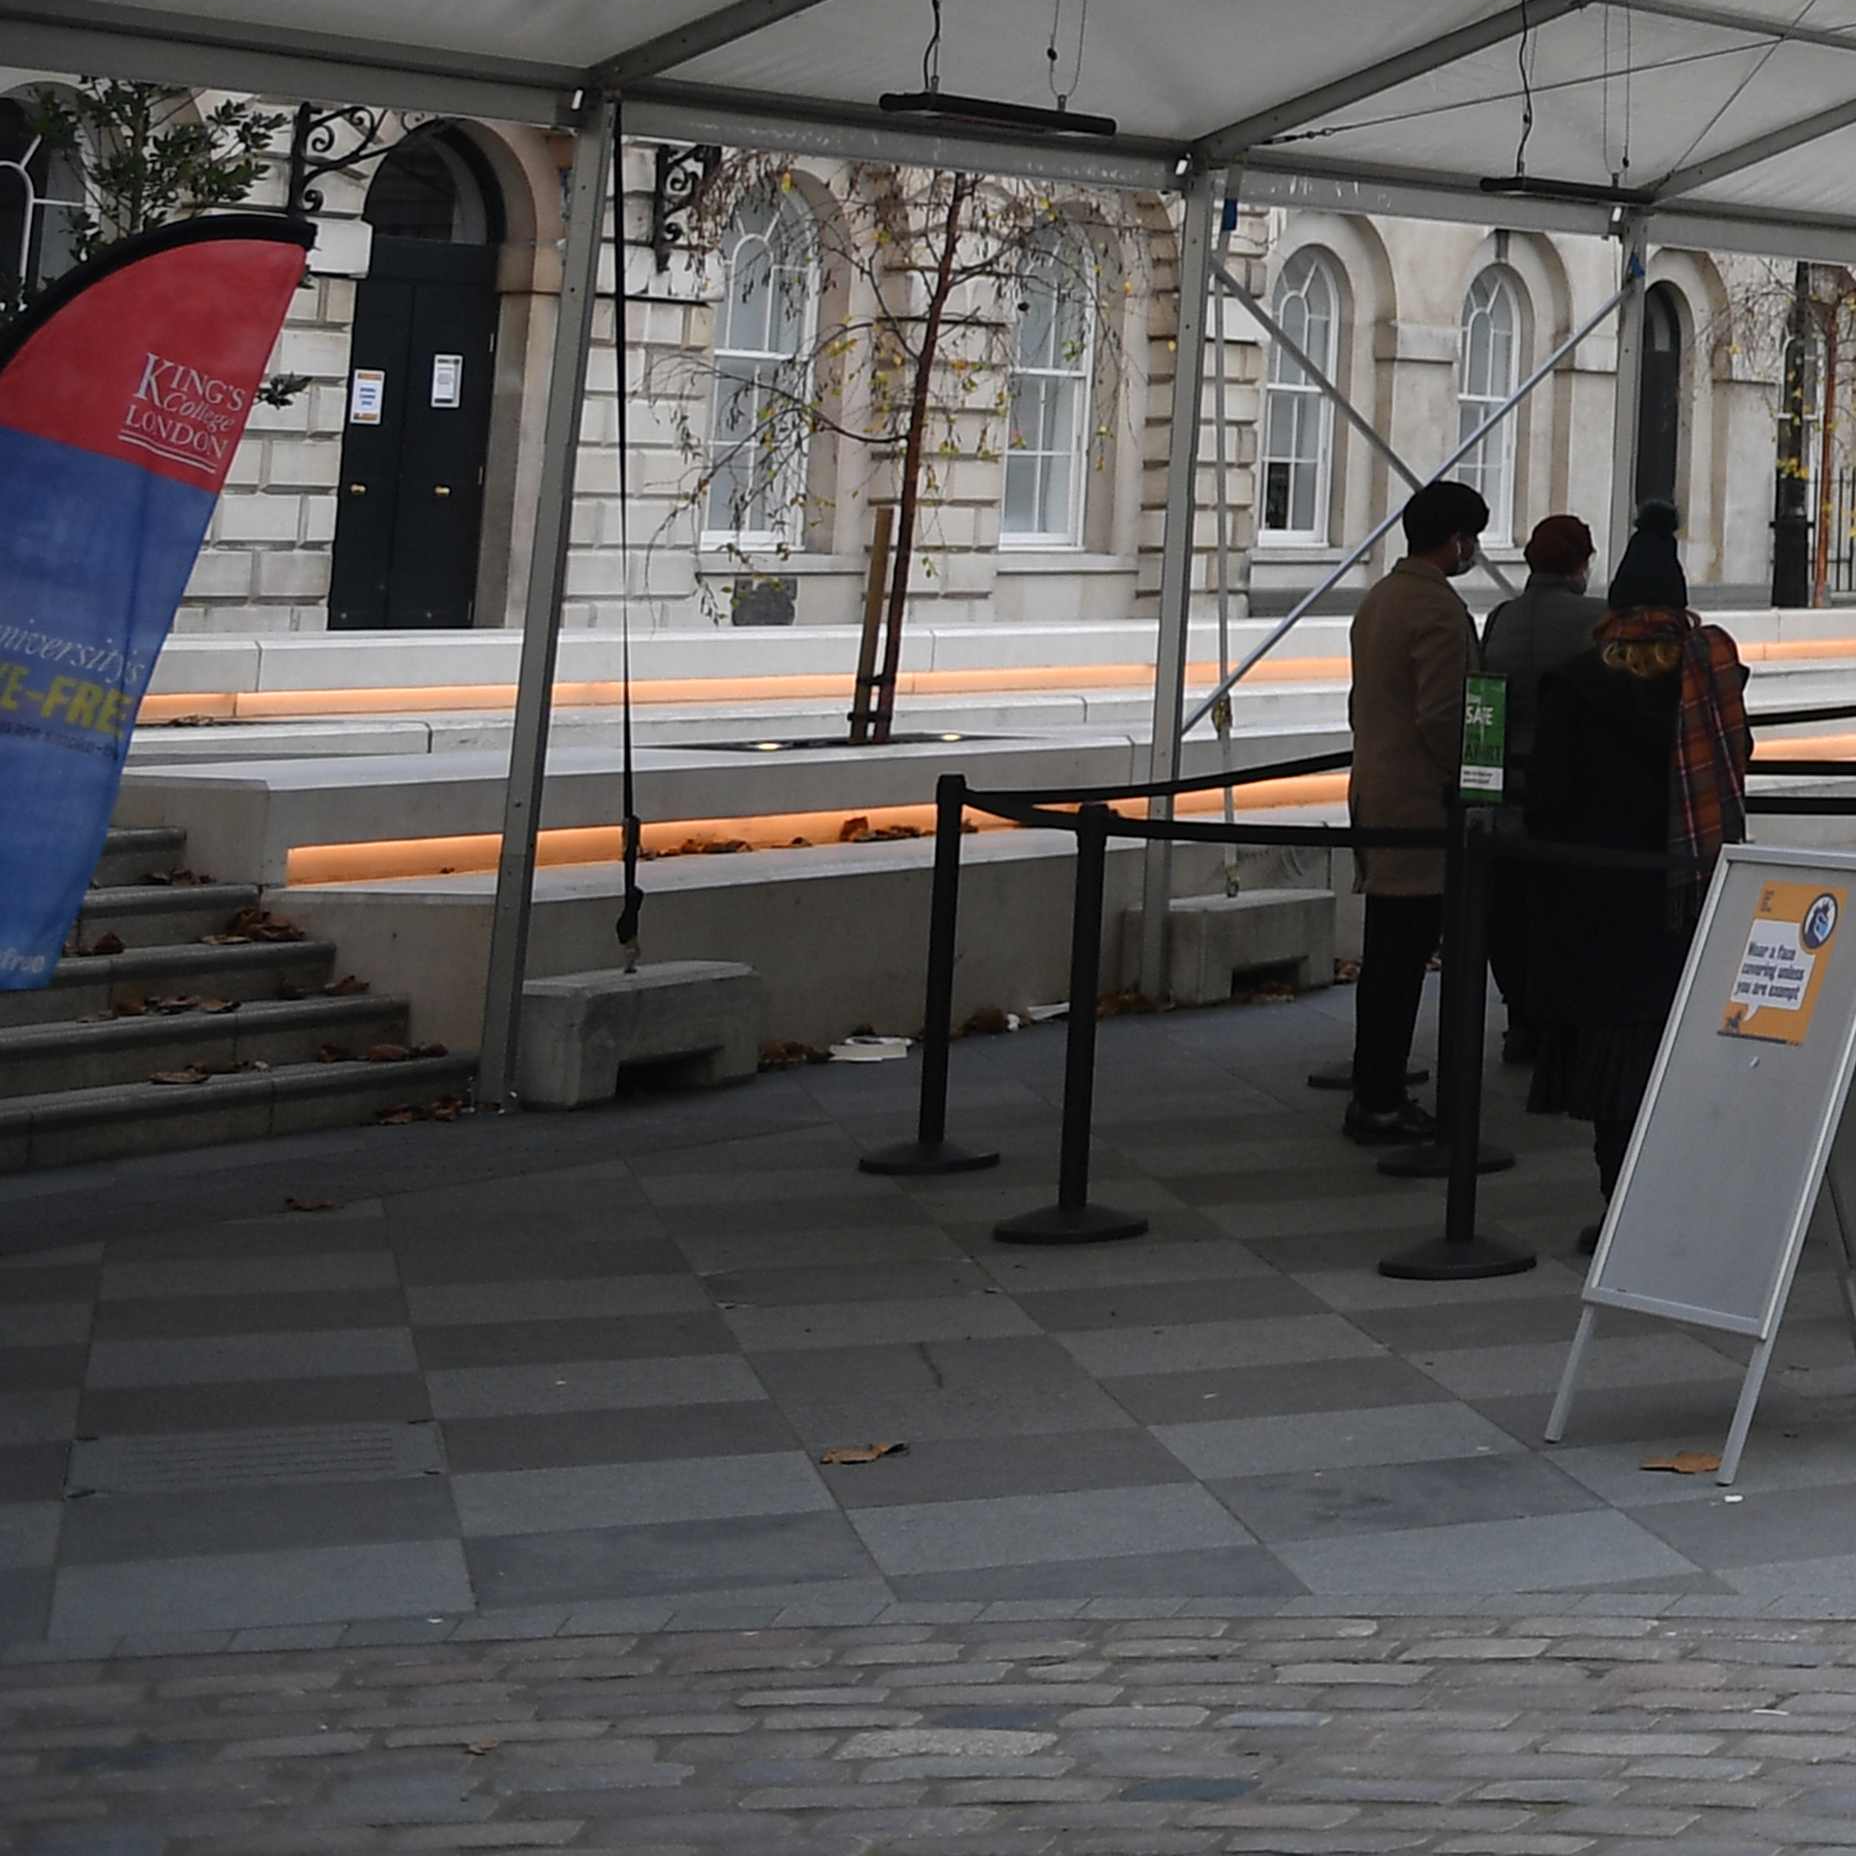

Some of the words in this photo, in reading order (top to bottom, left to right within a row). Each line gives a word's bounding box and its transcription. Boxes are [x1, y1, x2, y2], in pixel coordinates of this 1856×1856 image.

[132, 352, 246, 411] KING'S
[125, 404, 228, 459] LONDON
[163, 392, 235, 433] College
